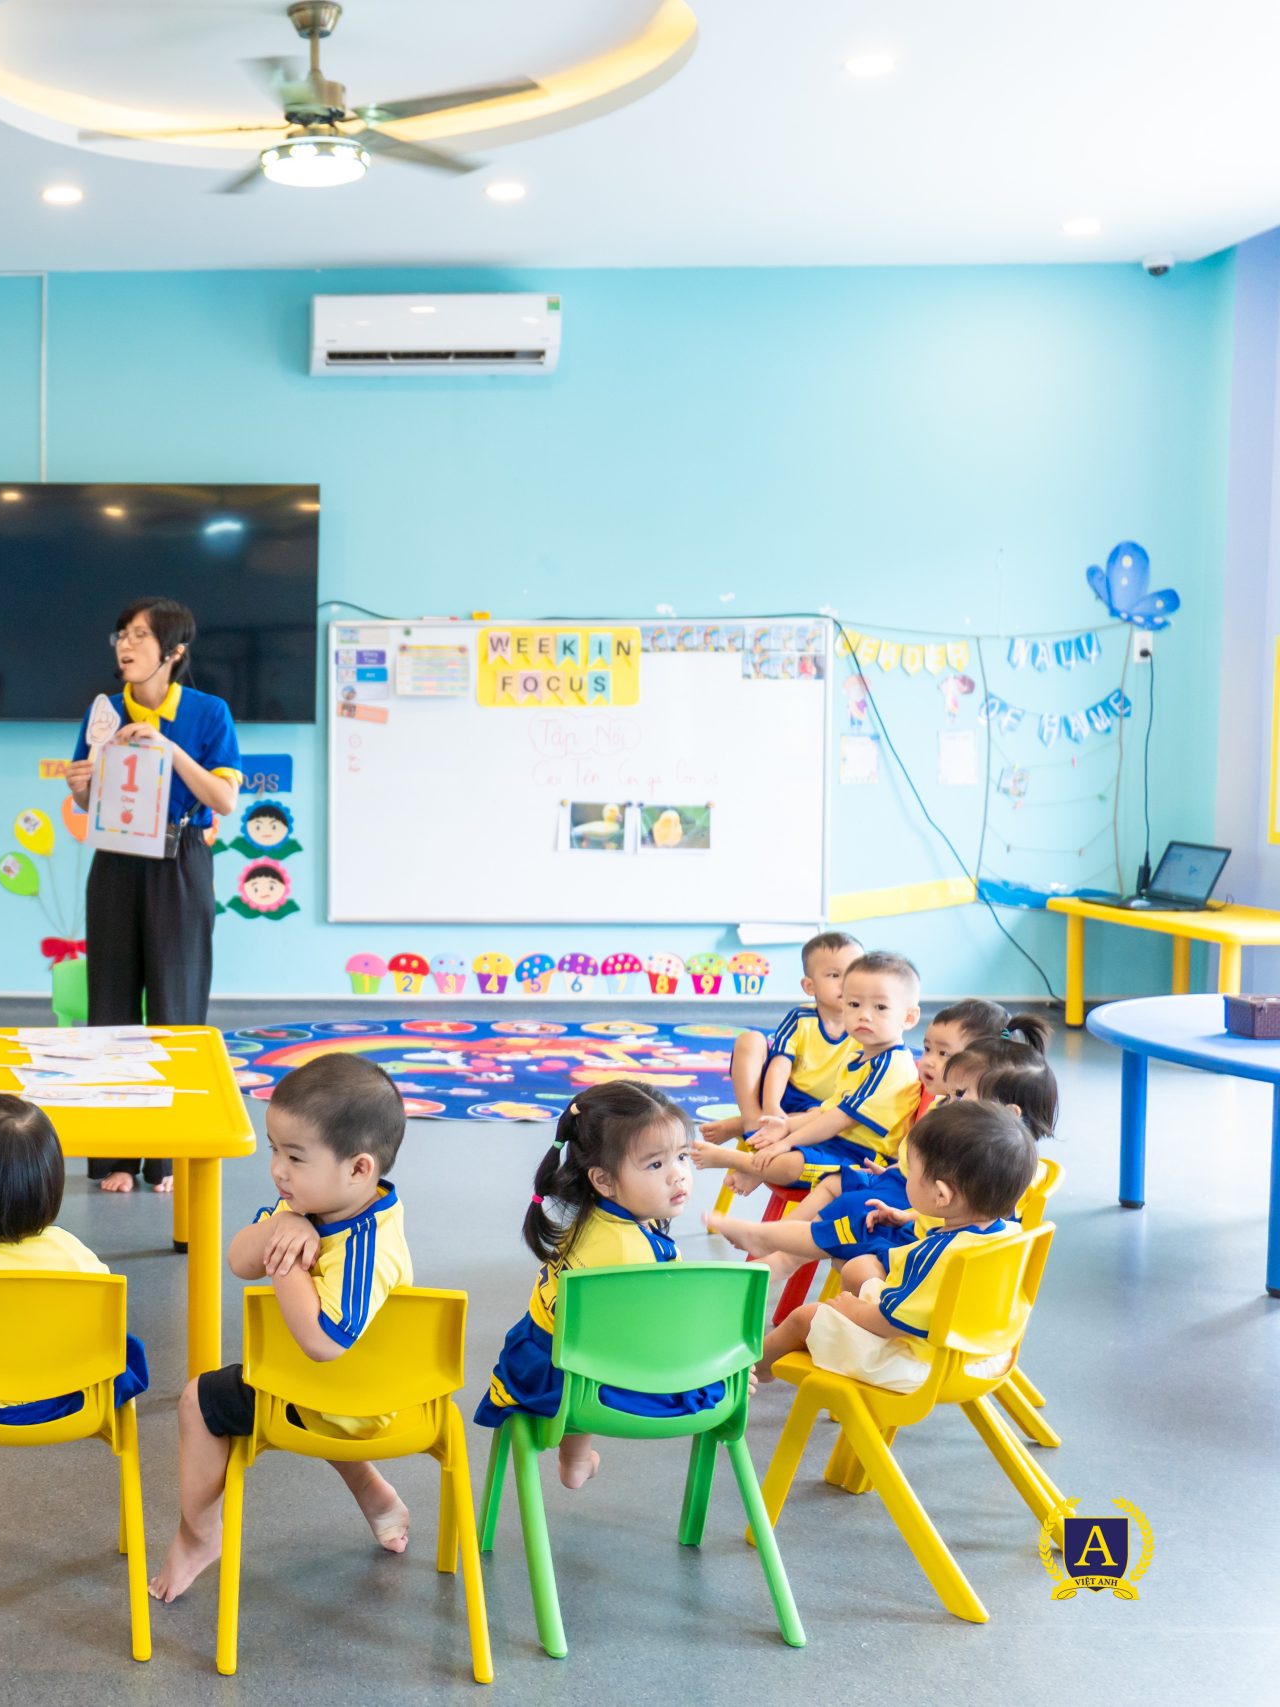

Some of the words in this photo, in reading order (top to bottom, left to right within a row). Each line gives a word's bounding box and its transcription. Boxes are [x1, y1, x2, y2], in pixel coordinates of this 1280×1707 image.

[489, 636, 576, 656] WEEK
[598, 638, 632, 656] IN
[501, 675, 607, 693] FOCUS
[121, 754, 139, 793] 1
[402, 975, 413, 992] 2
[443, 974, 456, 993] 3
[485, 973, 499, 993] 4
[530, 976, 542, 993] 5
[571, 975, 583, 993] 6
[614, 974, 626, 993] 7
[655, 974, 669, 994] 8
[700, 974, 715, 994] 9
[738, 974, 761, 994] 10
